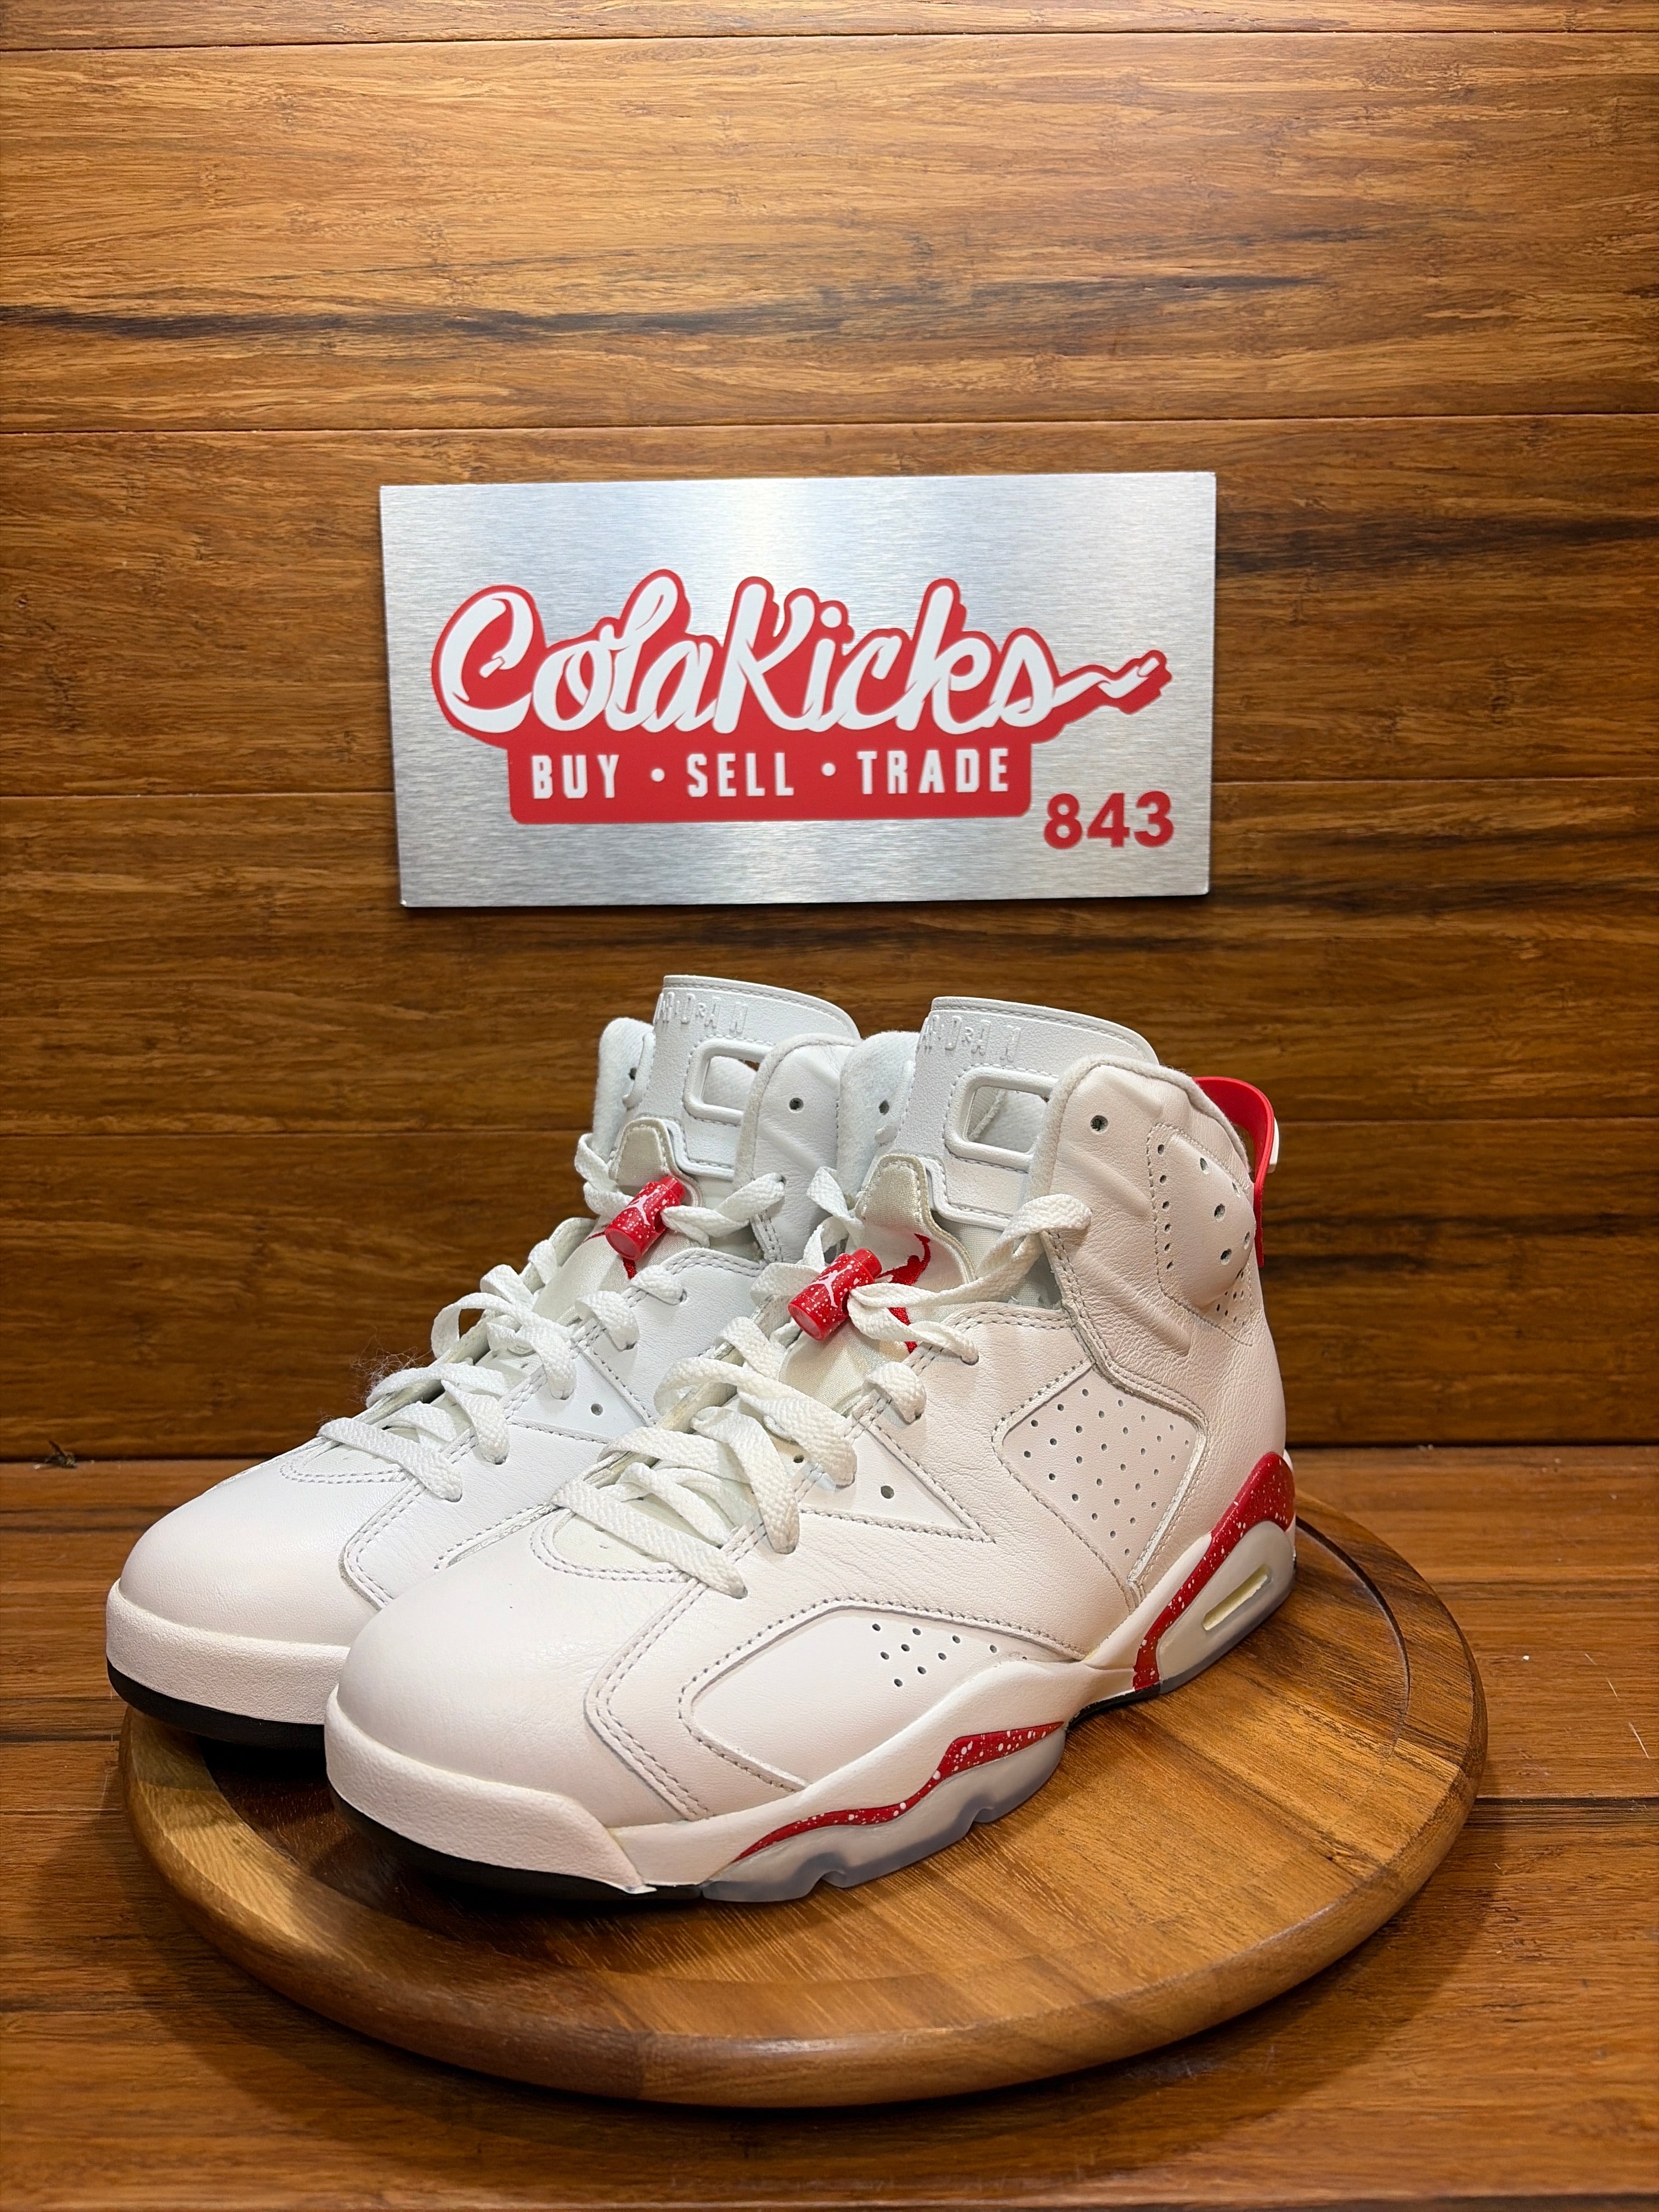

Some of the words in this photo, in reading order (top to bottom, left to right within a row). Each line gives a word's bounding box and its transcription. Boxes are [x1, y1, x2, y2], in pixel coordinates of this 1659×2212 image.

[439, 575, 1160, 736] ColaKicks
[531, 754, 619, 799] BUY
[686, 752, 794, 798] SELL
[856, 747, 1009, 795] TRADE
[1044, 791, 1173, 849] 843
